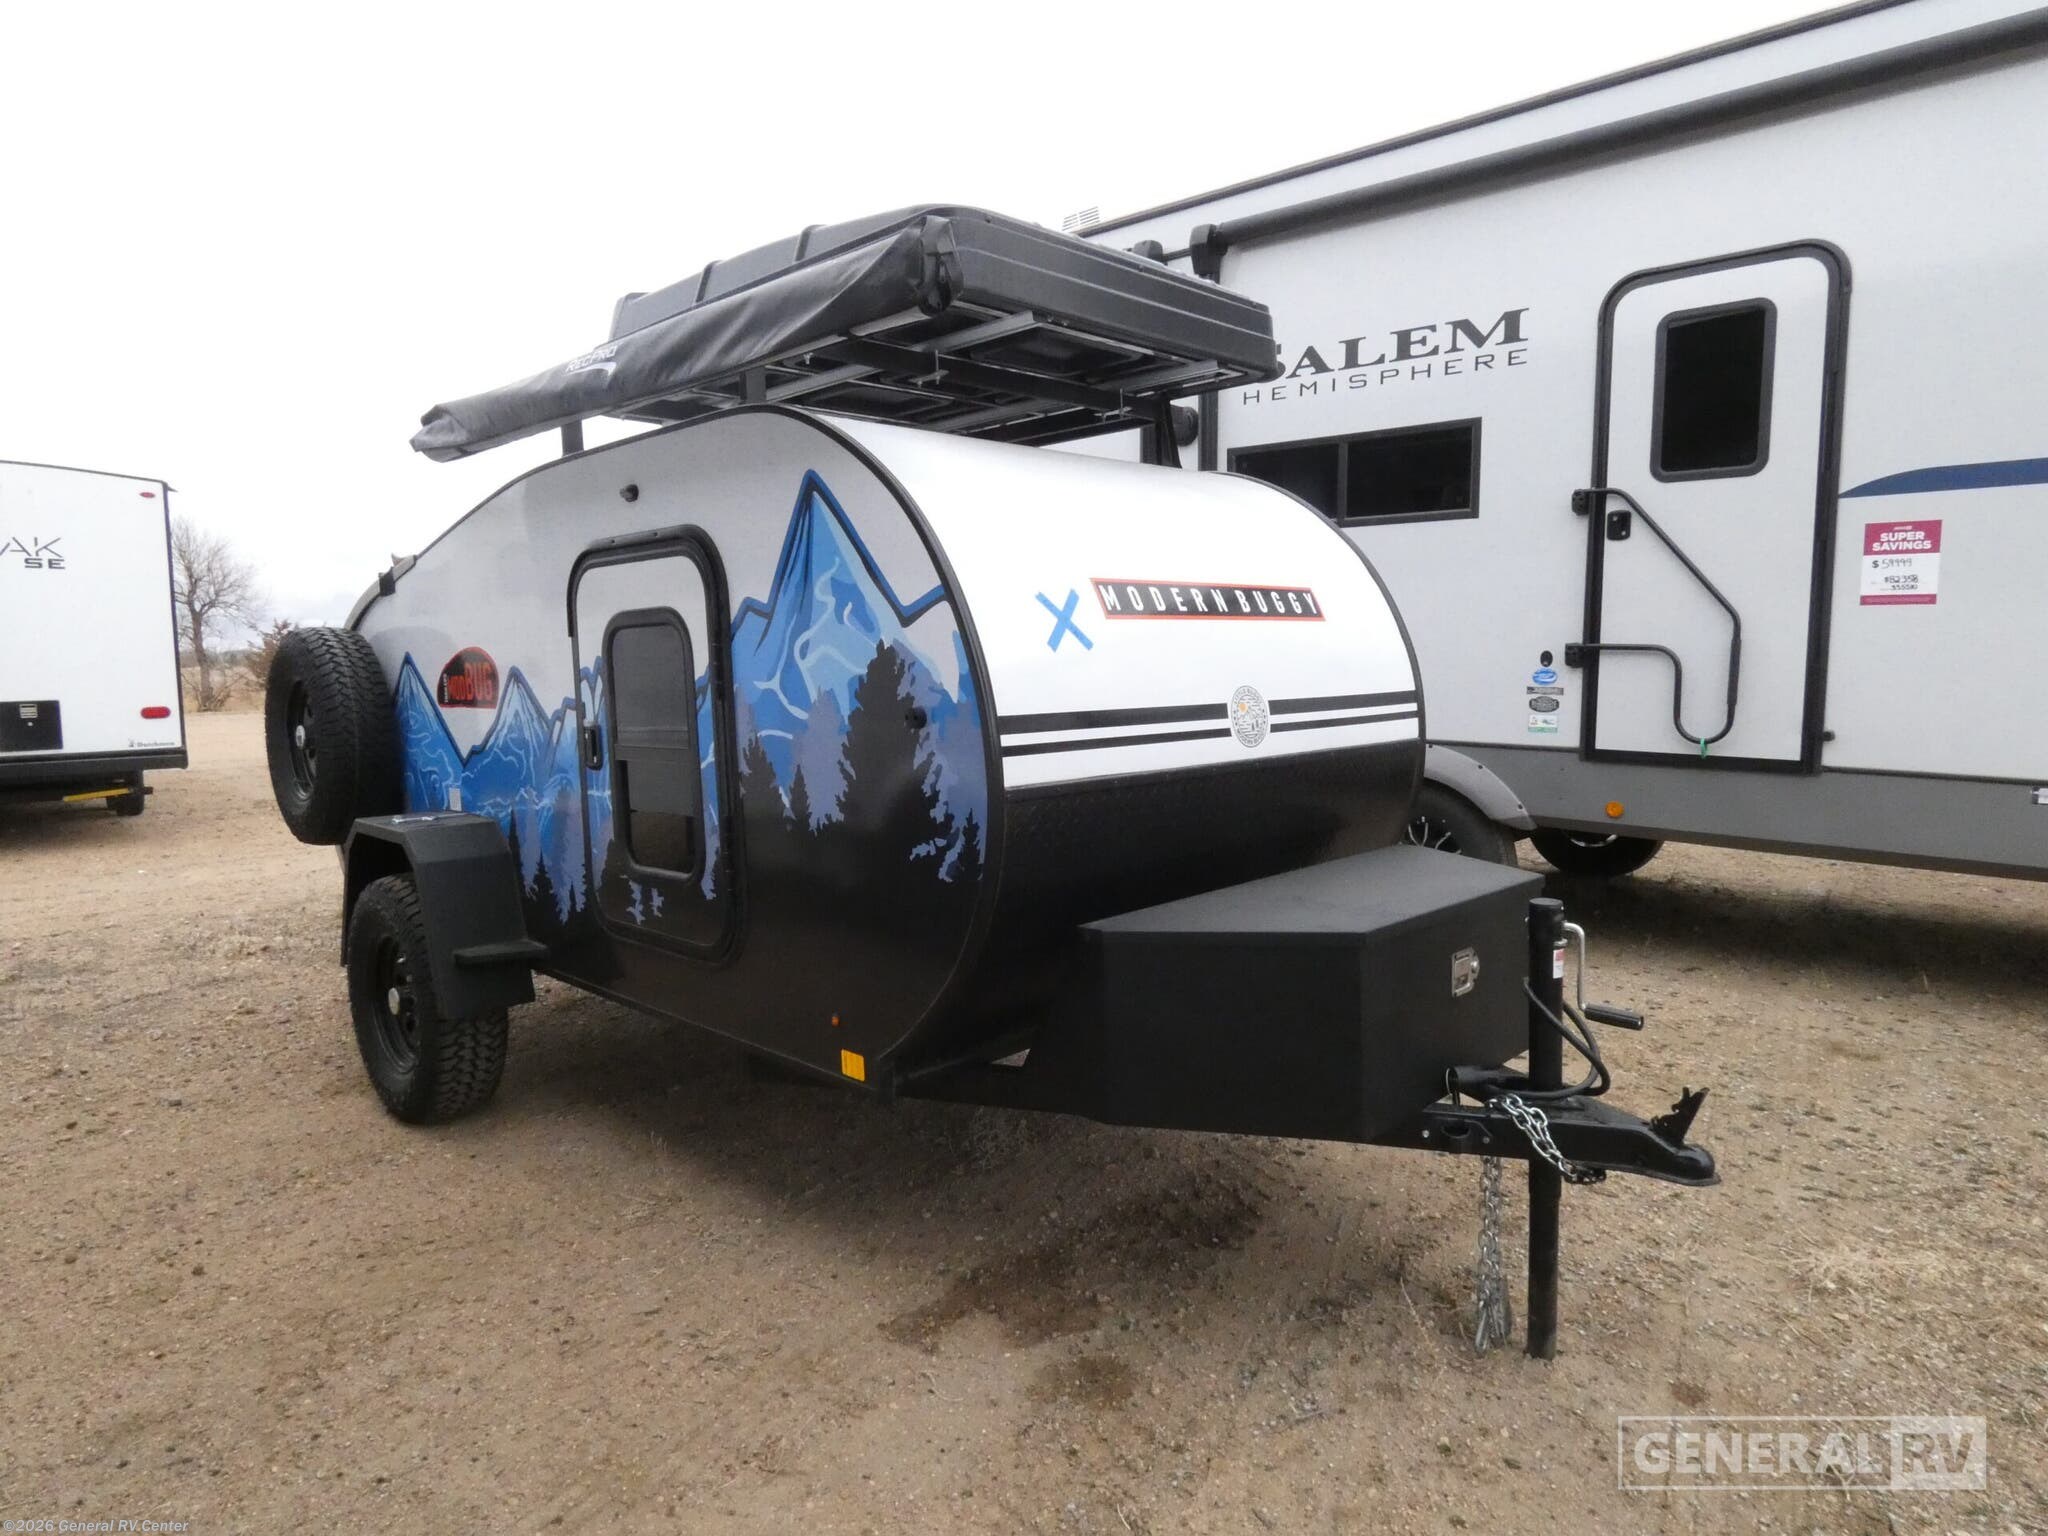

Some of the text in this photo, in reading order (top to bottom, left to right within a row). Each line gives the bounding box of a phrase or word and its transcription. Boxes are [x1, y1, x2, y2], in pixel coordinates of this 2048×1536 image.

[1277, 307, 1530, 380] ALEM
[1243, 348, 1528, 406] HEMISPHERE
[1872, 540, 1932, 552] SAVINGS
[1880, 531, 1925, 542] SUPER
[24, 557, 66, 570] SE
[1098, 584, 1318, 615] MODERN BUGGY
